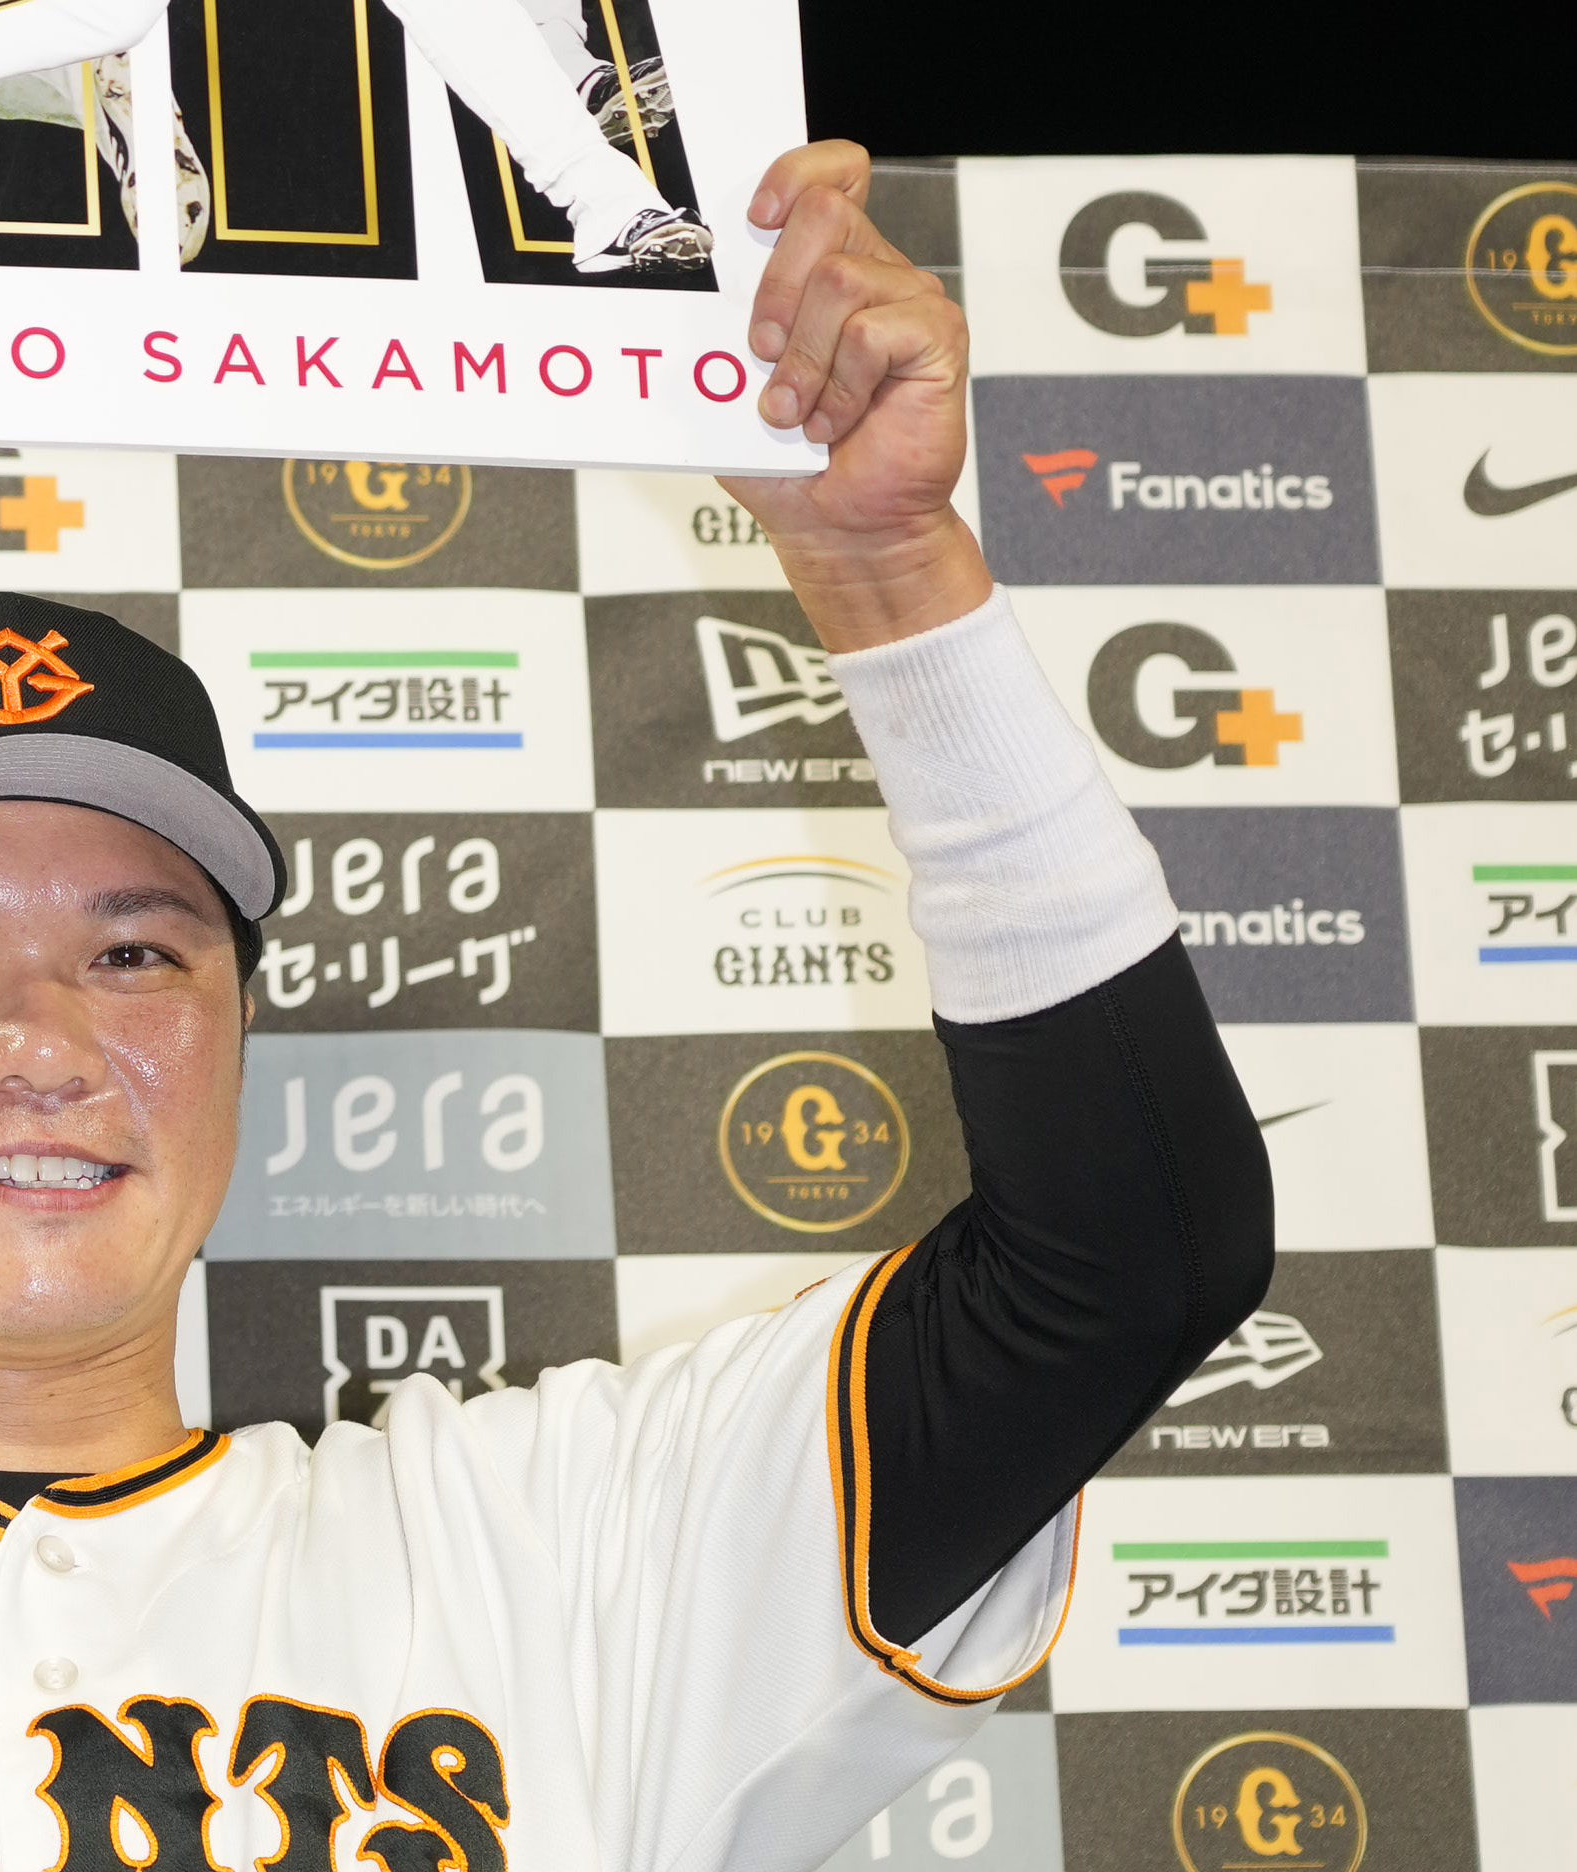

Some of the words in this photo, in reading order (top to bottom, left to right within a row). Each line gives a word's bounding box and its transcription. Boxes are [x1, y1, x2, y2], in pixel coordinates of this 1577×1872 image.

[1059, 191, 1270, 338] G+
[1532, 310, 1577, 326] TOKY
[142, 330, 747, 403] SAKAMOTO
[308, 464, 337, 484] 19
[415, 463, 451, 484] 34
[1109, 462, 1332, 509] Fanatics
[694, 505, 770, 547] GIA
[264, 678, 509, 722] アイダ設計
[1087, 622, 1301, 770] G+
[741, 907, 862, 927] CLUB
[1182, 901, 1364, 947] anatics
[714, 942, 894, 986] GIANTS
[742, 1122, 773, 1144] 19
[781, 1086, 845, 1170] G
[855, 1121, 888, 1144] 34
[366, 1316, 465, 1368] DA
[1129, 1569, 1380, 1616] アイダ設計
[1196, 1806, 1227, 1828] 19
[1235, 1768, 1302, 1855] G
[1311, 1805, 1346, 1827] 34
